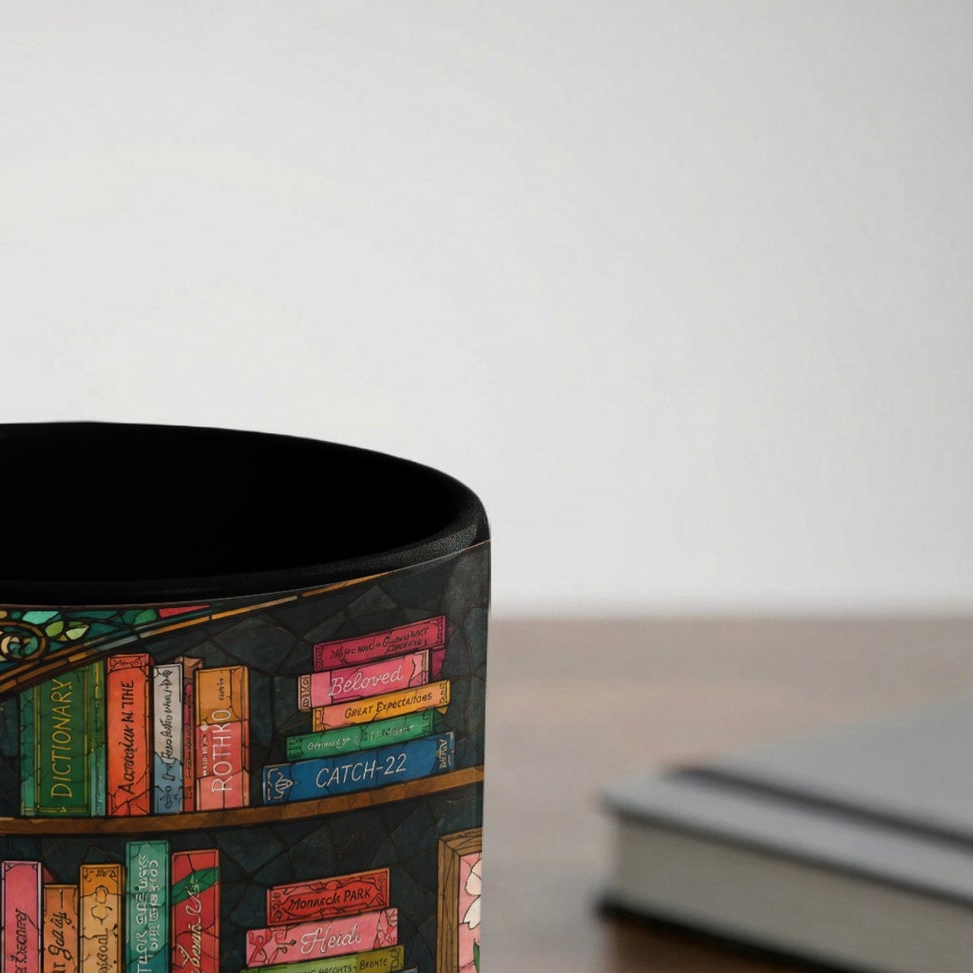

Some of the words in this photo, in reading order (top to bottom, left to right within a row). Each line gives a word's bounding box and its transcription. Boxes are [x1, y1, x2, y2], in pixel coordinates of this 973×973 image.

[328, 664, 404, 697] Beloved
[50, 677, 73, 799] DICTIONARY
[211, 708, 233, 794] ROTHKO
[315, 752, 407, 788] CATCH-22
[343, 887, 372, 903] PARK
[300, 923, 363, 955] Heidi
